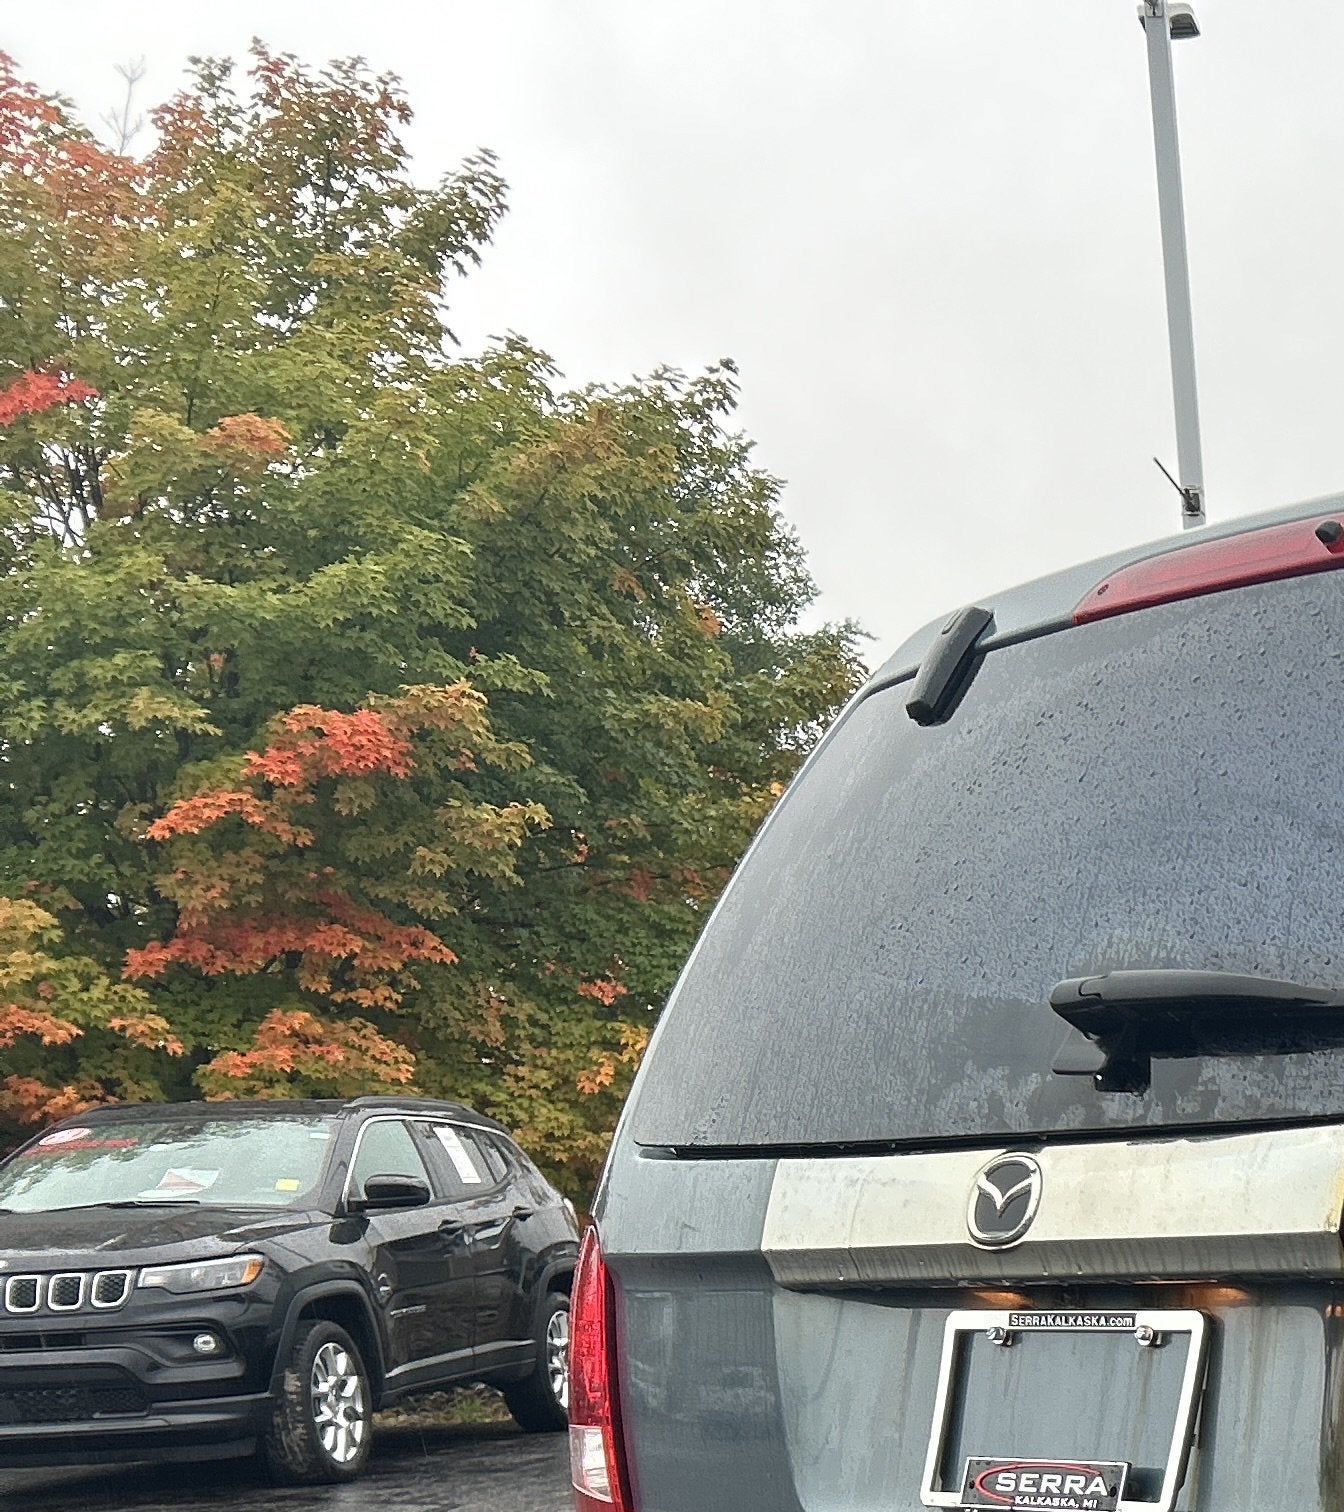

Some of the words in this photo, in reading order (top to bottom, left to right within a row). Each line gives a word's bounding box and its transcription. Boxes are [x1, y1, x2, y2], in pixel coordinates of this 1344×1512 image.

[995, 1472, 1108, 1496] SERRA
[1014, 1495, 1079, 1508] KALKASKA,
[1083, 1498, 1098, 1509] MI
